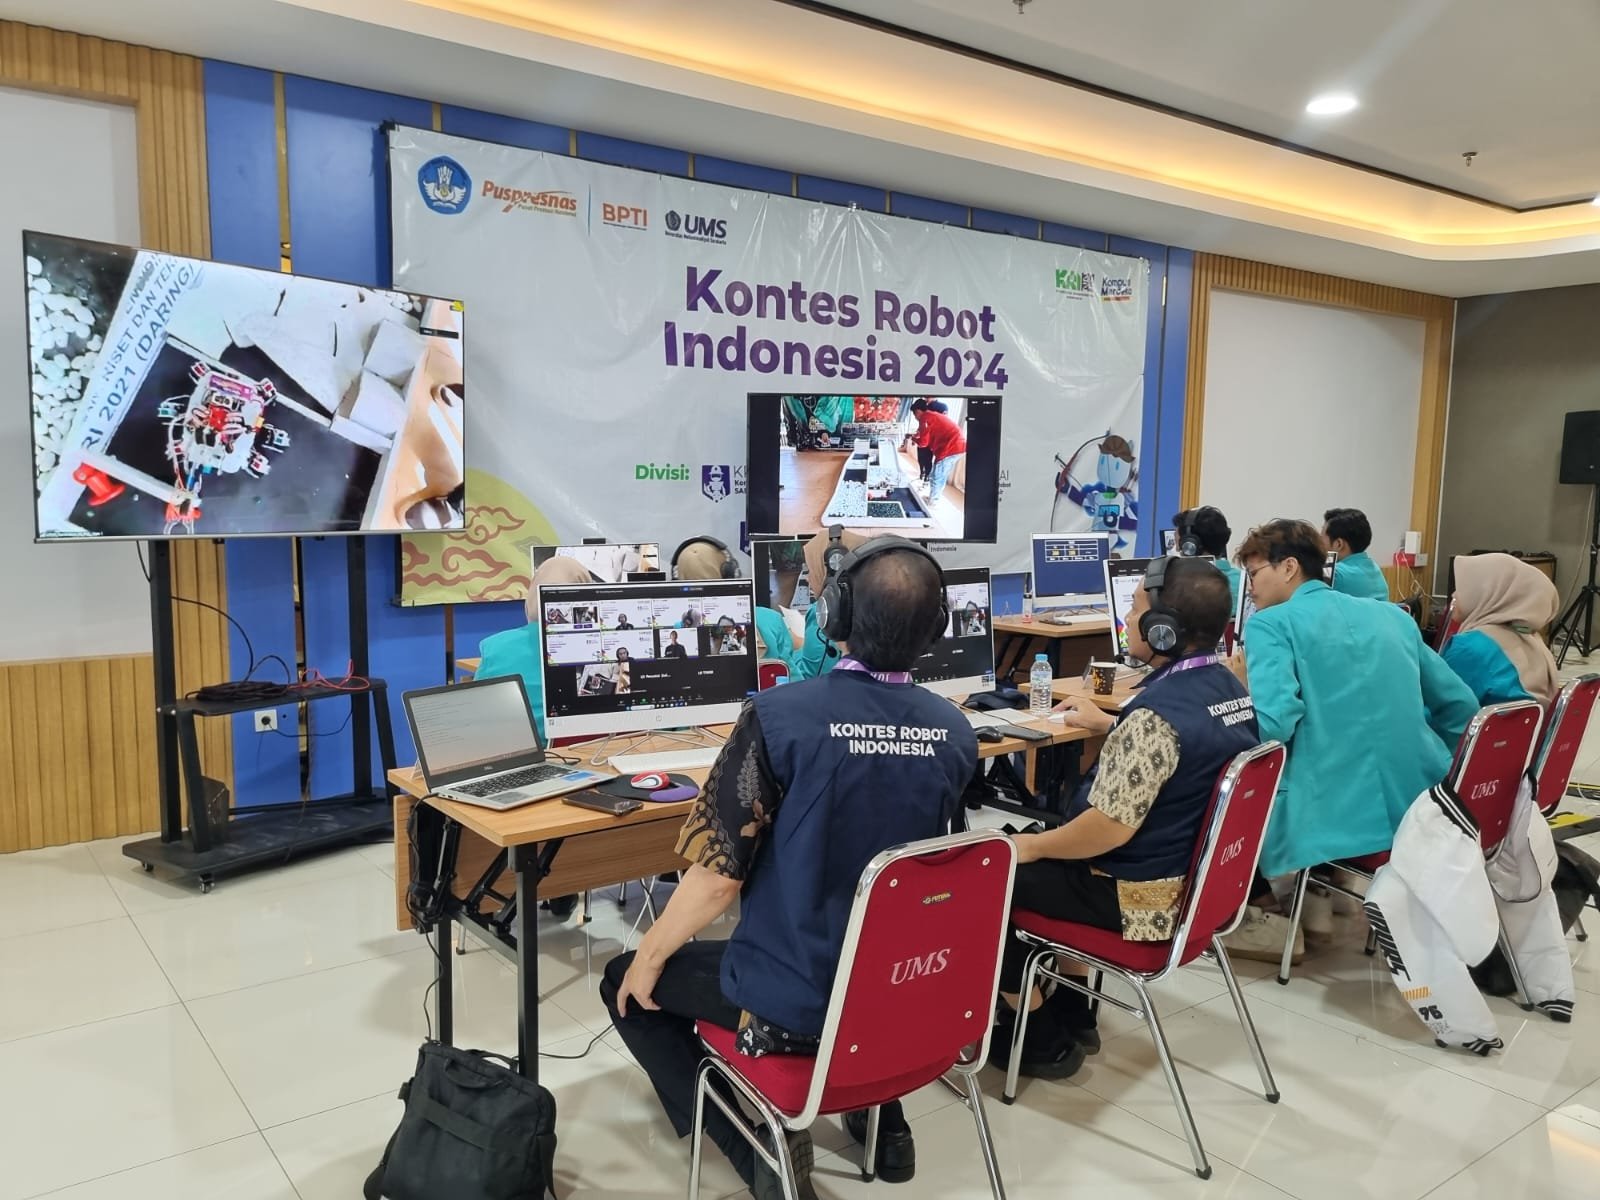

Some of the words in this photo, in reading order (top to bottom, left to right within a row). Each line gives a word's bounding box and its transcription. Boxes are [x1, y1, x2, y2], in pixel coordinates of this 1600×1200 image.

[603, 203, 647, 227] BPTI
[684, 214, 727, 238] UMS
[131, 290, 157, 328] DAN
[686, 266, 860, 328] Kontes
[874, 289, 996, 343] Robot
[98, 365, 136, 421] 2021
[135, 263, 194, 361] (DARING)
[664, 321, 901, 383] Indonesia
[914, 345, 1009, 390] 2024
[635, 462, 690, 481] Divisi:
[1207, 699, 1239, 718] KONTES
[829, 723, 897, 739] KONTES
[899, 726, 949, 742] ROBOT
[849, 740, 936, 757] INDONESIA
[1471, 779, 1500, 800] UMS
[1219, 837, 1245, 866] UMS
[890, 948, 952, 985] UMS
